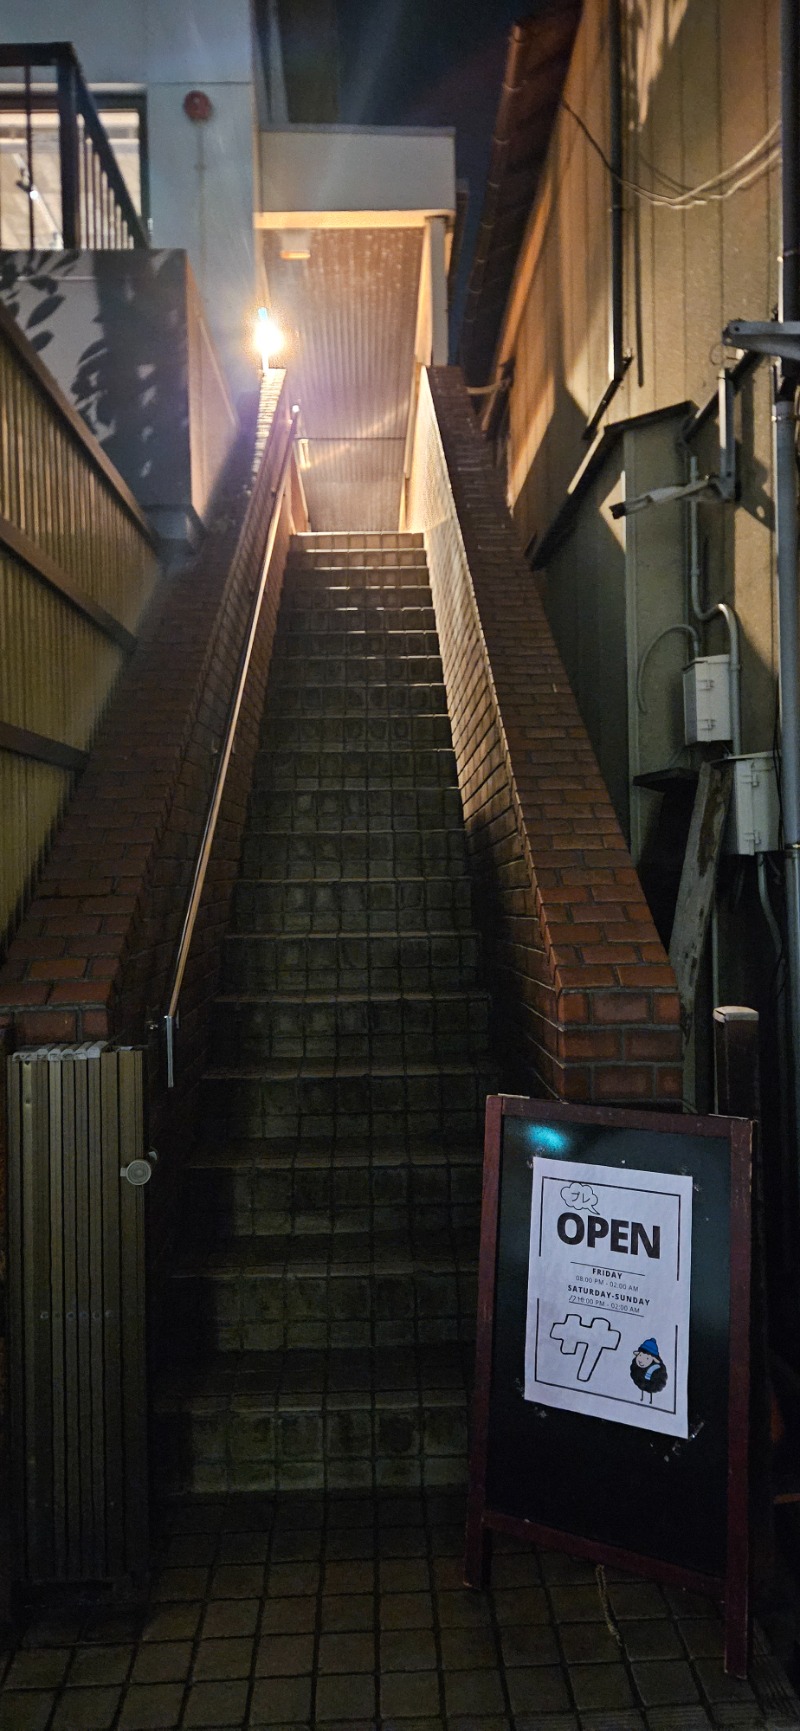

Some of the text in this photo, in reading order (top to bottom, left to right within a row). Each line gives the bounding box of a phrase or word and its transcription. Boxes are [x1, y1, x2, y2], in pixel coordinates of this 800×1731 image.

[557, 1211, 661, 1260] OPEN
[592, 1268, 623, 1280] FRIDAY
[567, 1284, 650, 1306] SATURDAY-SUNDAY
